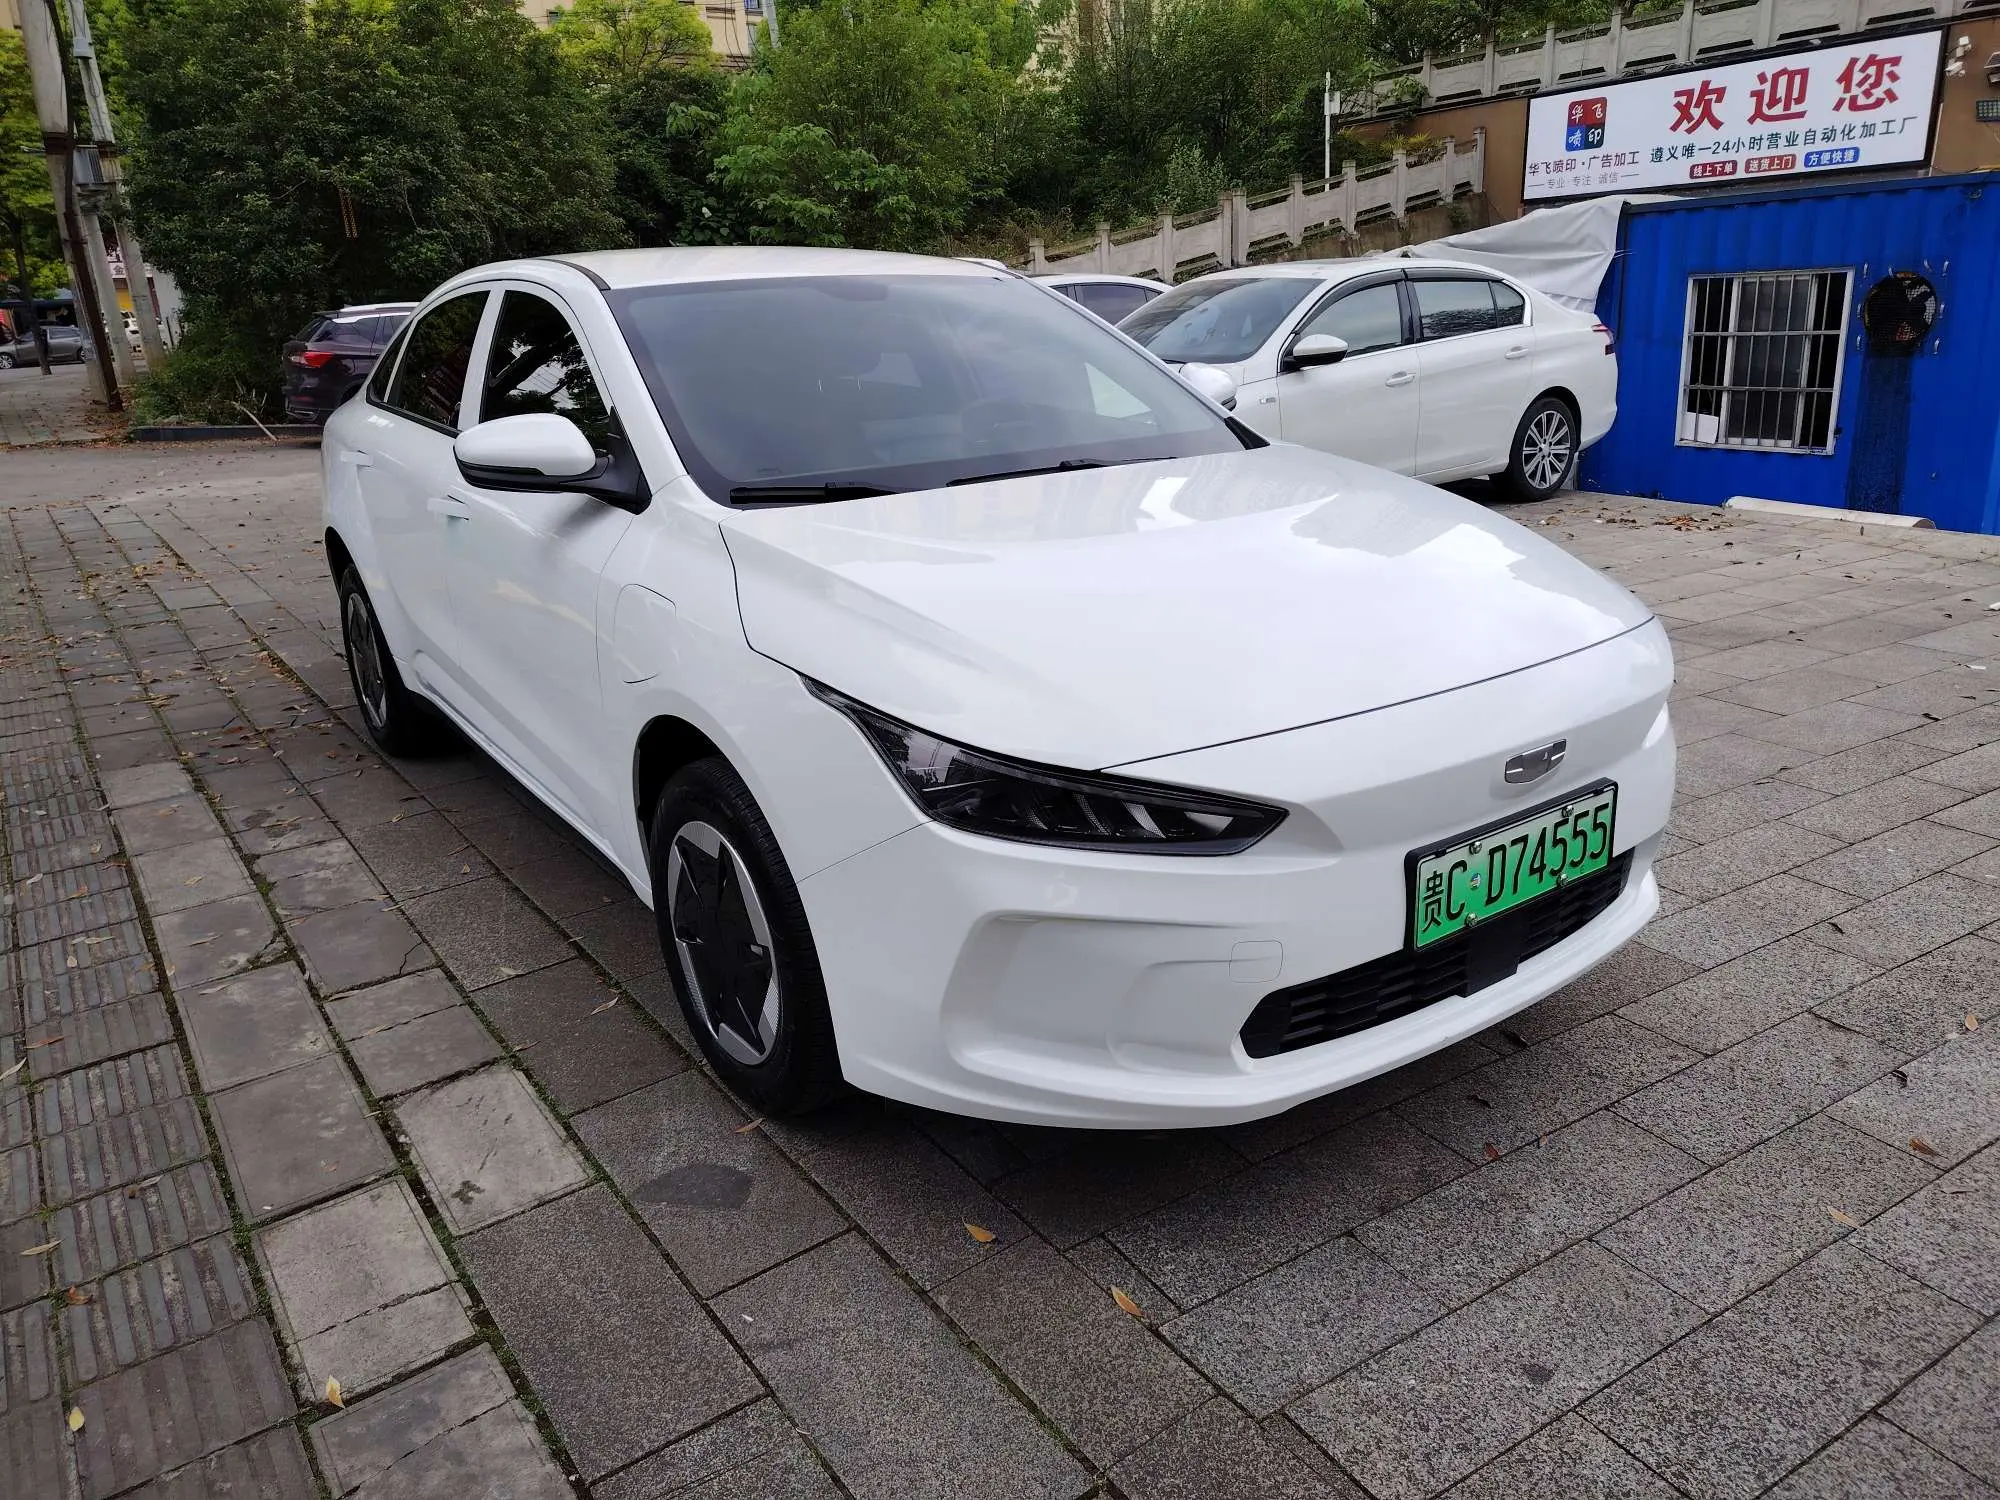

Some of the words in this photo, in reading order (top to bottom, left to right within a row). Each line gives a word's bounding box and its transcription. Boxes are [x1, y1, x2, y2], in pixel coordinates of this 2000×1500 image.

[1670, 54, 1902, 134] 欢迎您
[1572, 104, 1604, 122] 华飞
[1568, 129, 1601, 147] 喷印
[1650, 116, 1918, 163] 遵义唯一24小时营业自动化加工厂
[1693, 163, 1733, 177] 线上下单
[1749, 158, 1792, 172] 送货上门
[1809, 147, 1855, 165] 方便快捷
